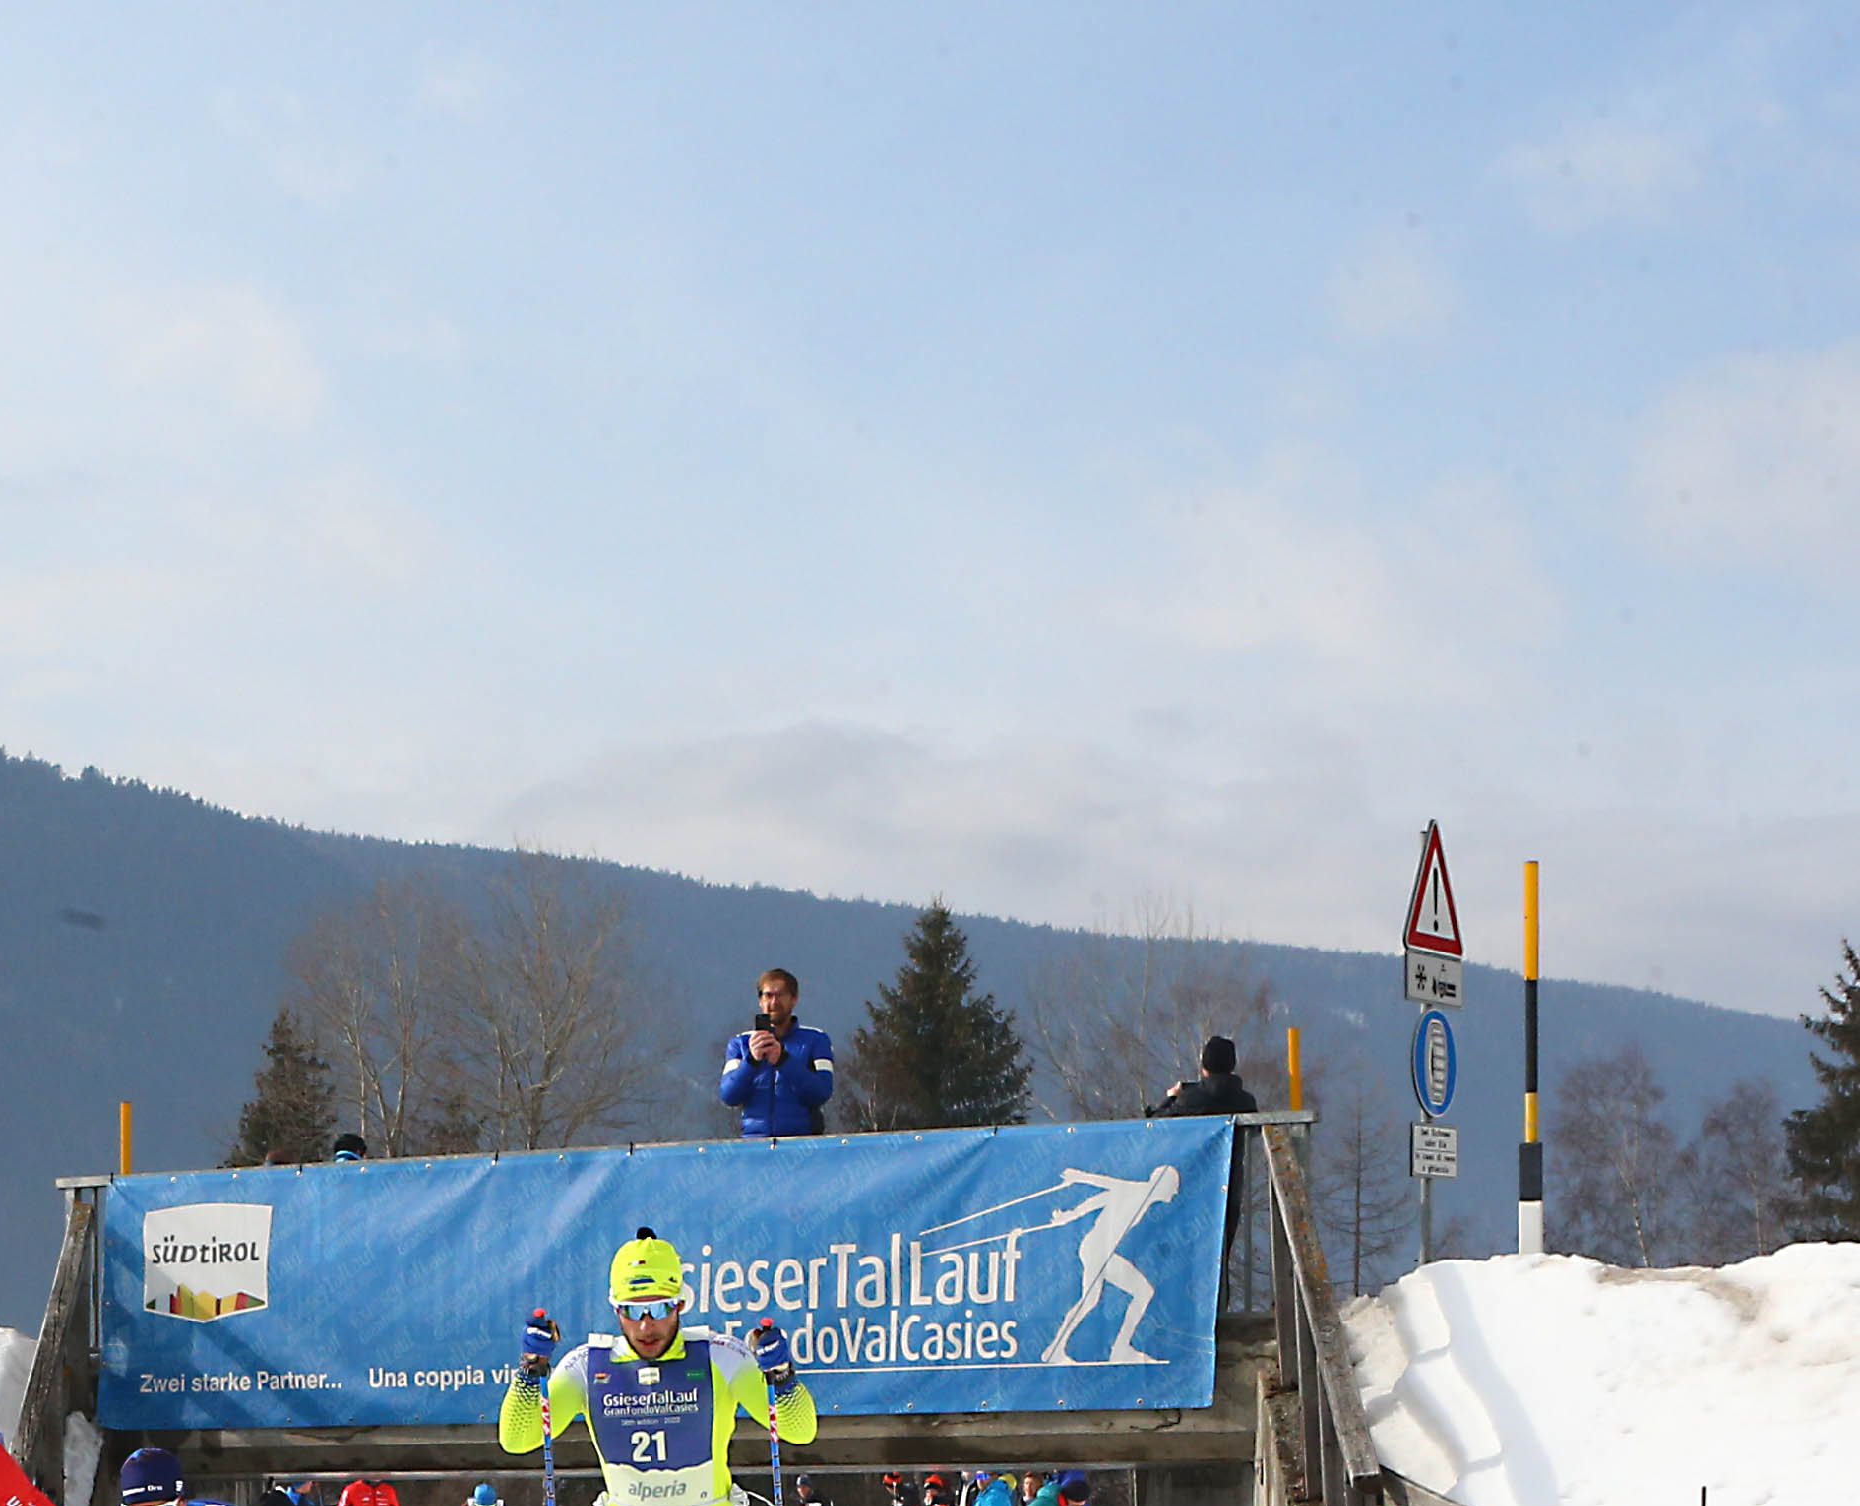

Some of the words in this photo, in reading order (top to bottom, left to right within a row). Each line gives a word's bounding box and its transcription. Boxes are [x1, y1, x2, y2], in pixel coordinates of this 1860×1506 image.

[681, 1227, 1023, 1315] sieserTalLauf
[140, 1373, 186, 1393] Zwei
[190, 1373, 252, 1393] starke
[256, 1370, 342, 1391] Partner...
[368, 1366, 408, 1389] Una
[414, 1366, 485, 1391] coppia
[602, 1387, 700, 1407] GsieserTalLauf
[603, 1402, 700, 1418] GranFondoValCasies
[630, 1431, 668, 1463] 21
[628, 1479, 688, 1502] alperia
